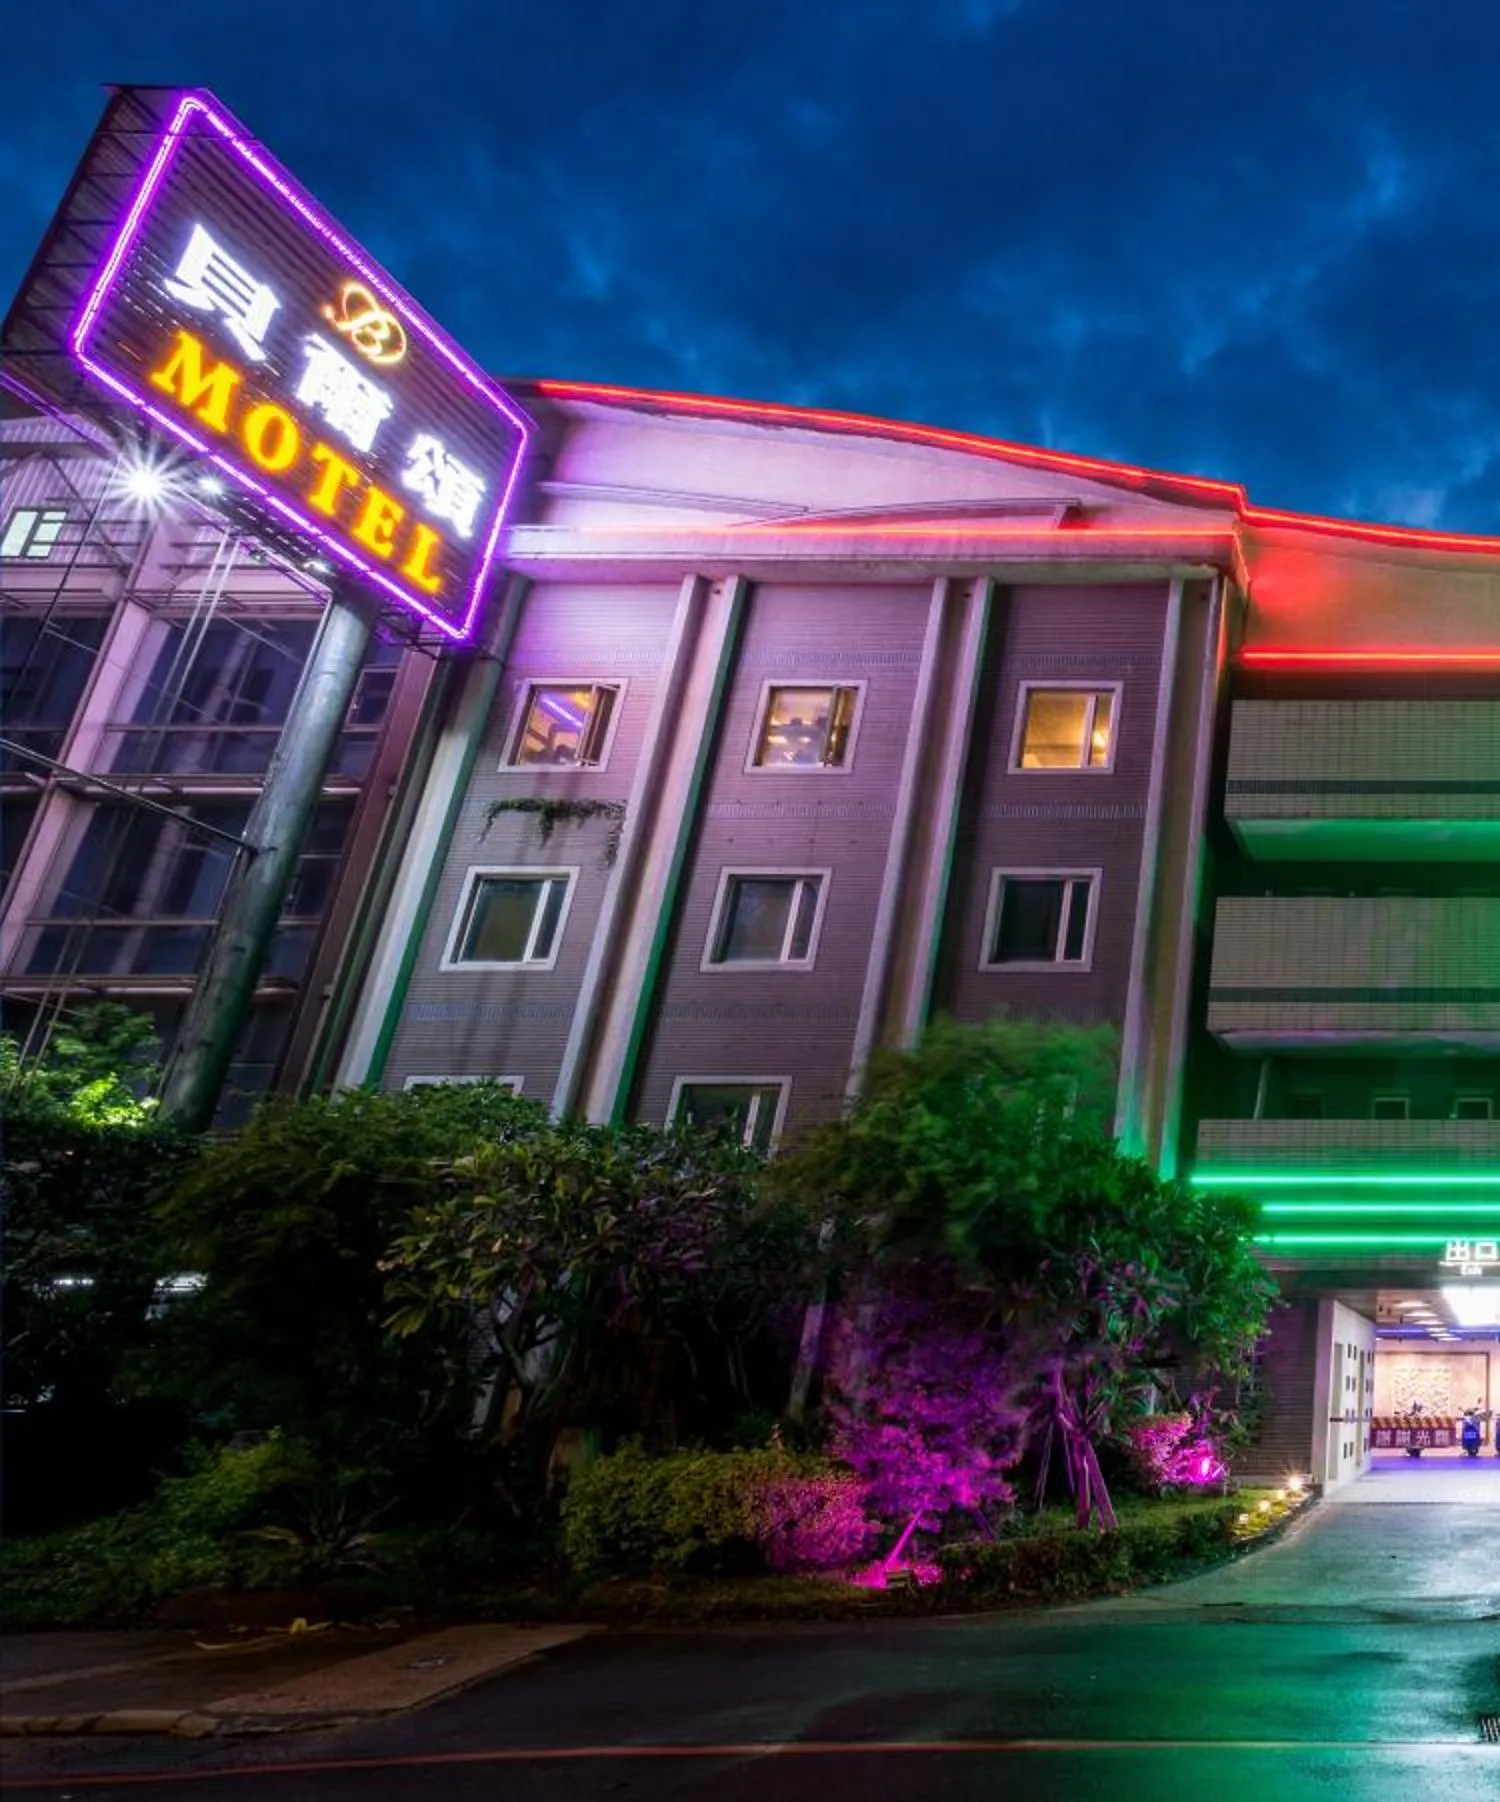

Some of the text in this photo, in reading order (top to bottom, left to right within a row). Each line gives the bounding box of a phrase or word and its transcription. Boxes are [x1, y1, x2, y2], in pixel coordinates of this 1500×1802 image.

[153, 331, 444, 594] MOTEL
[166, 223, 487, 536] 貝爾頌
[1446, 1240, 1499, 1261] 出口
